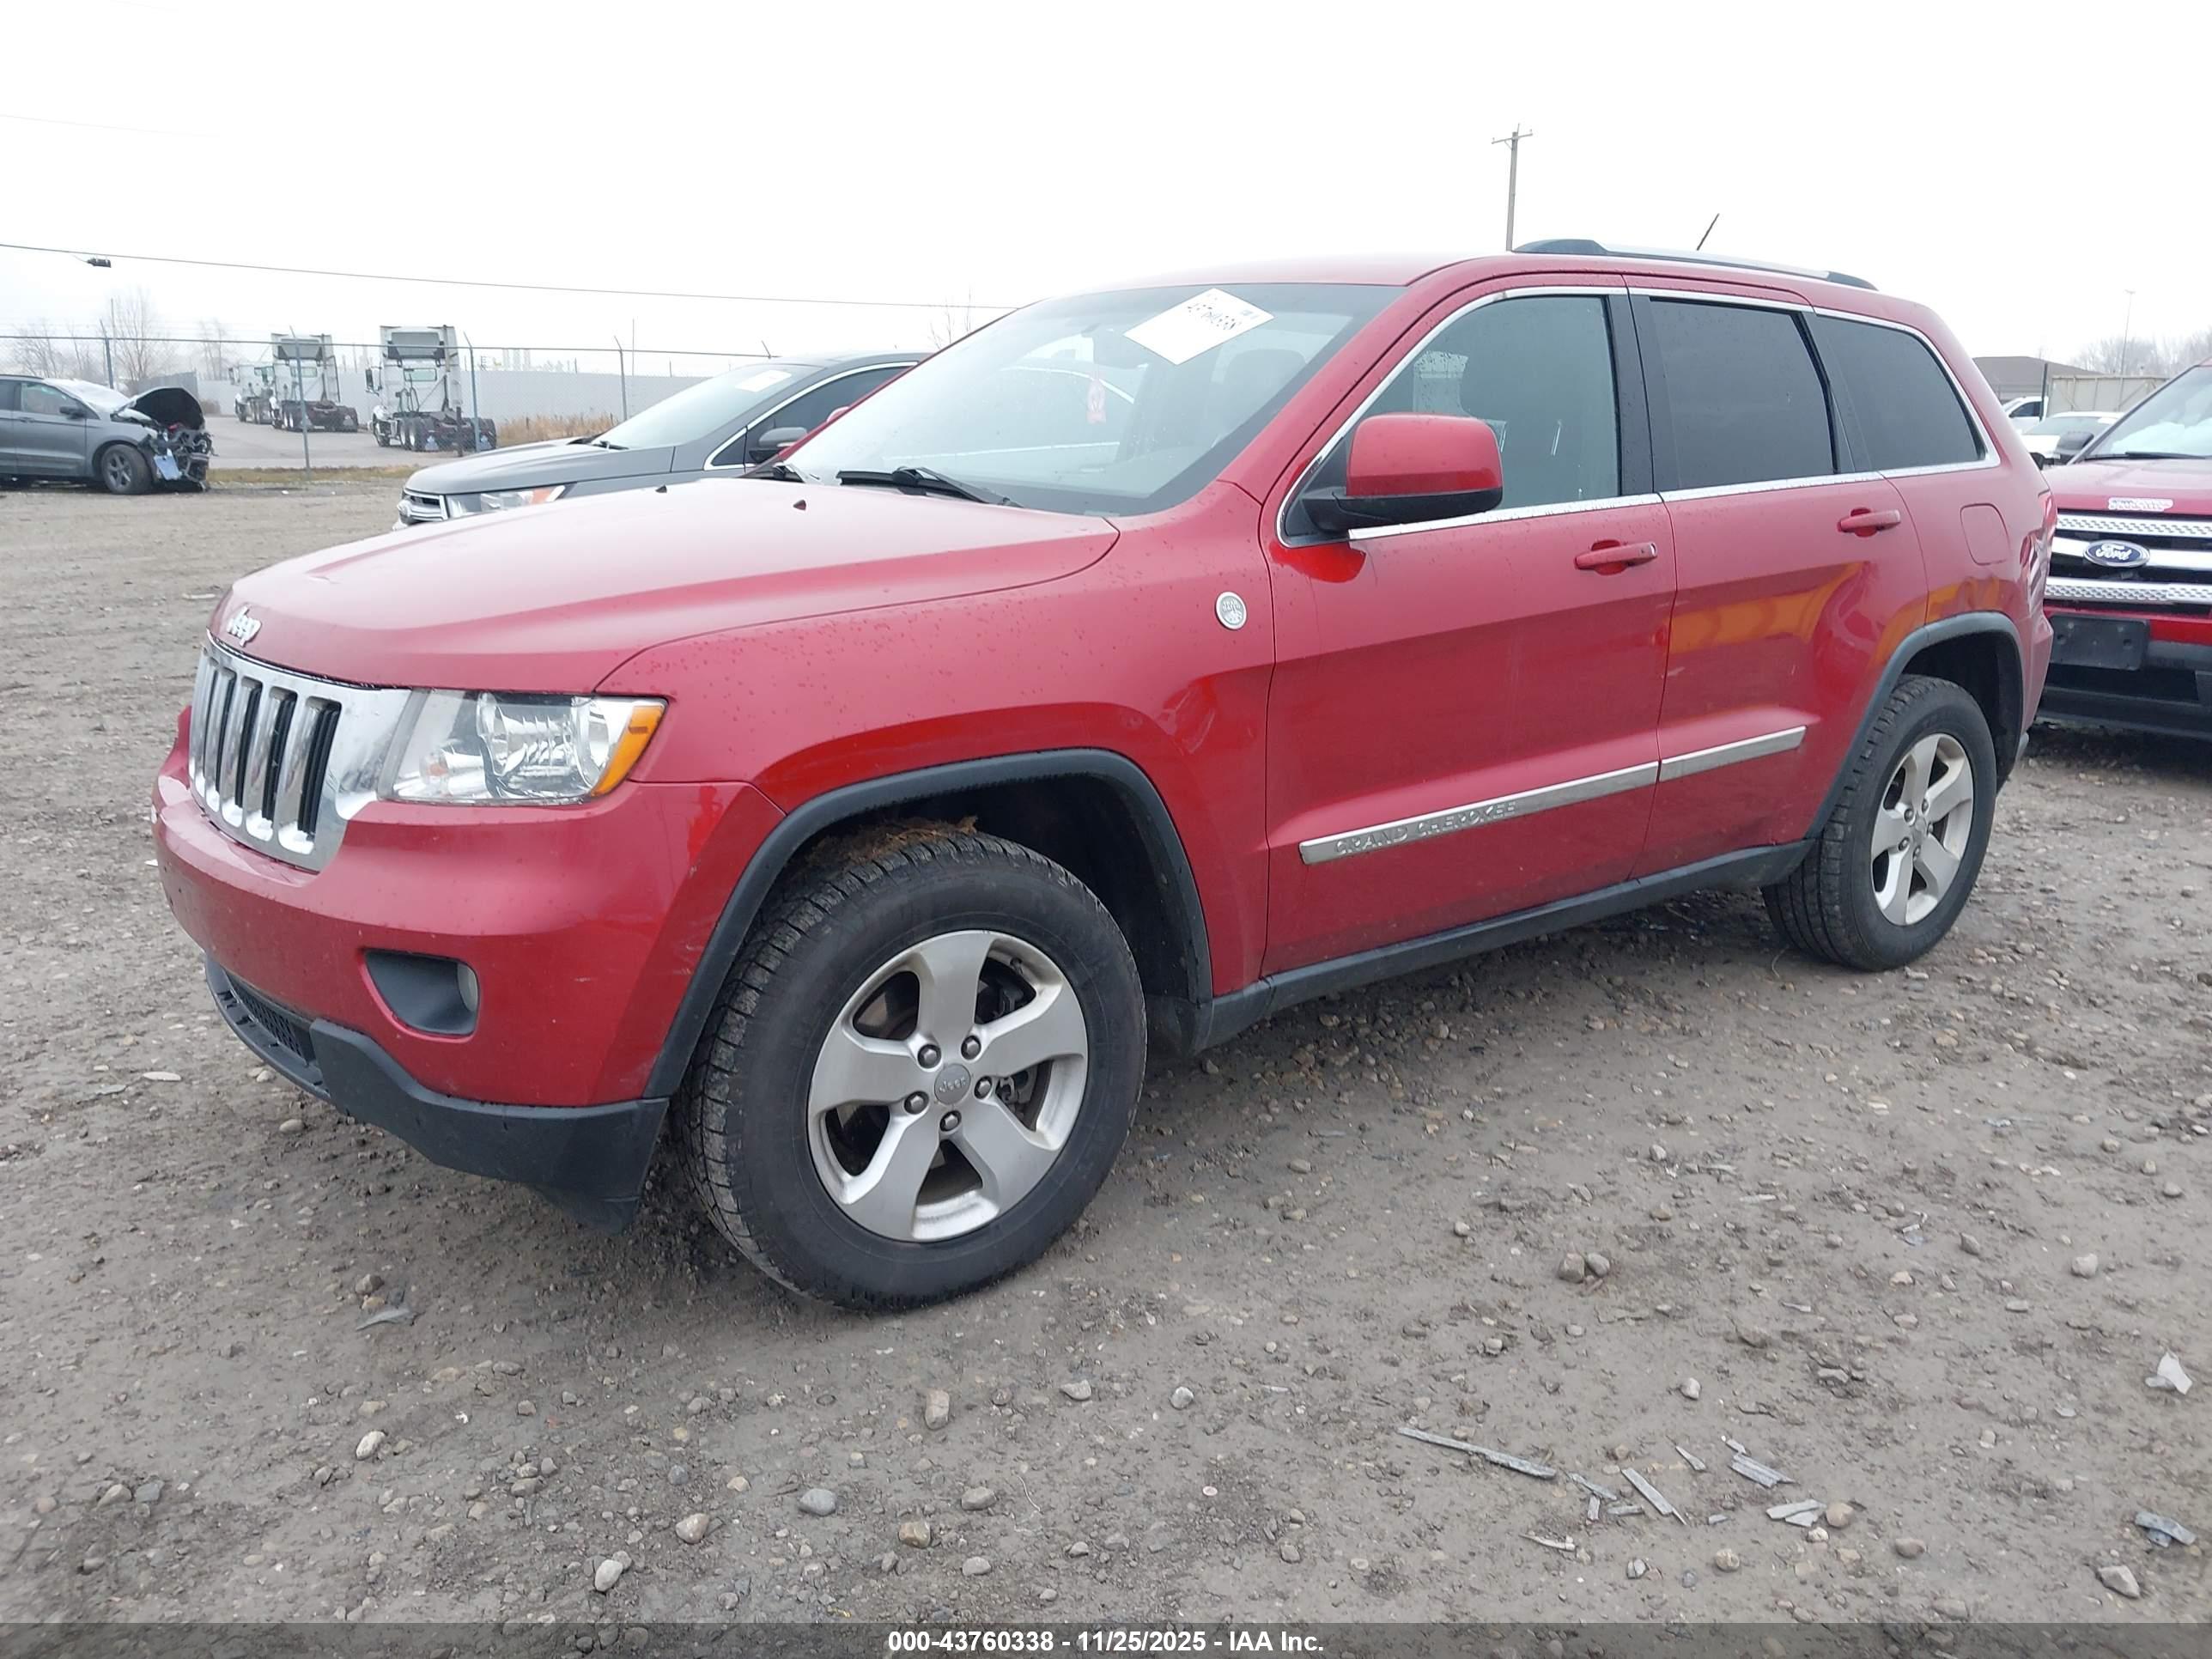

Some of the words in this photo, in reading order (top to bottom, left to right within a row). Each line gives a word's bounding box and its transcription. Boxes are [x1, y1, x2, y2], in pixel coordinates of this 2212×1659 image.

[2095, 544, 2133, 561] Ford
[226, 605, 262, 647] Jeep
[1335, 826, 1408, 855] GRAND
[1417, 800, 1516, 839] CHEROKEE
